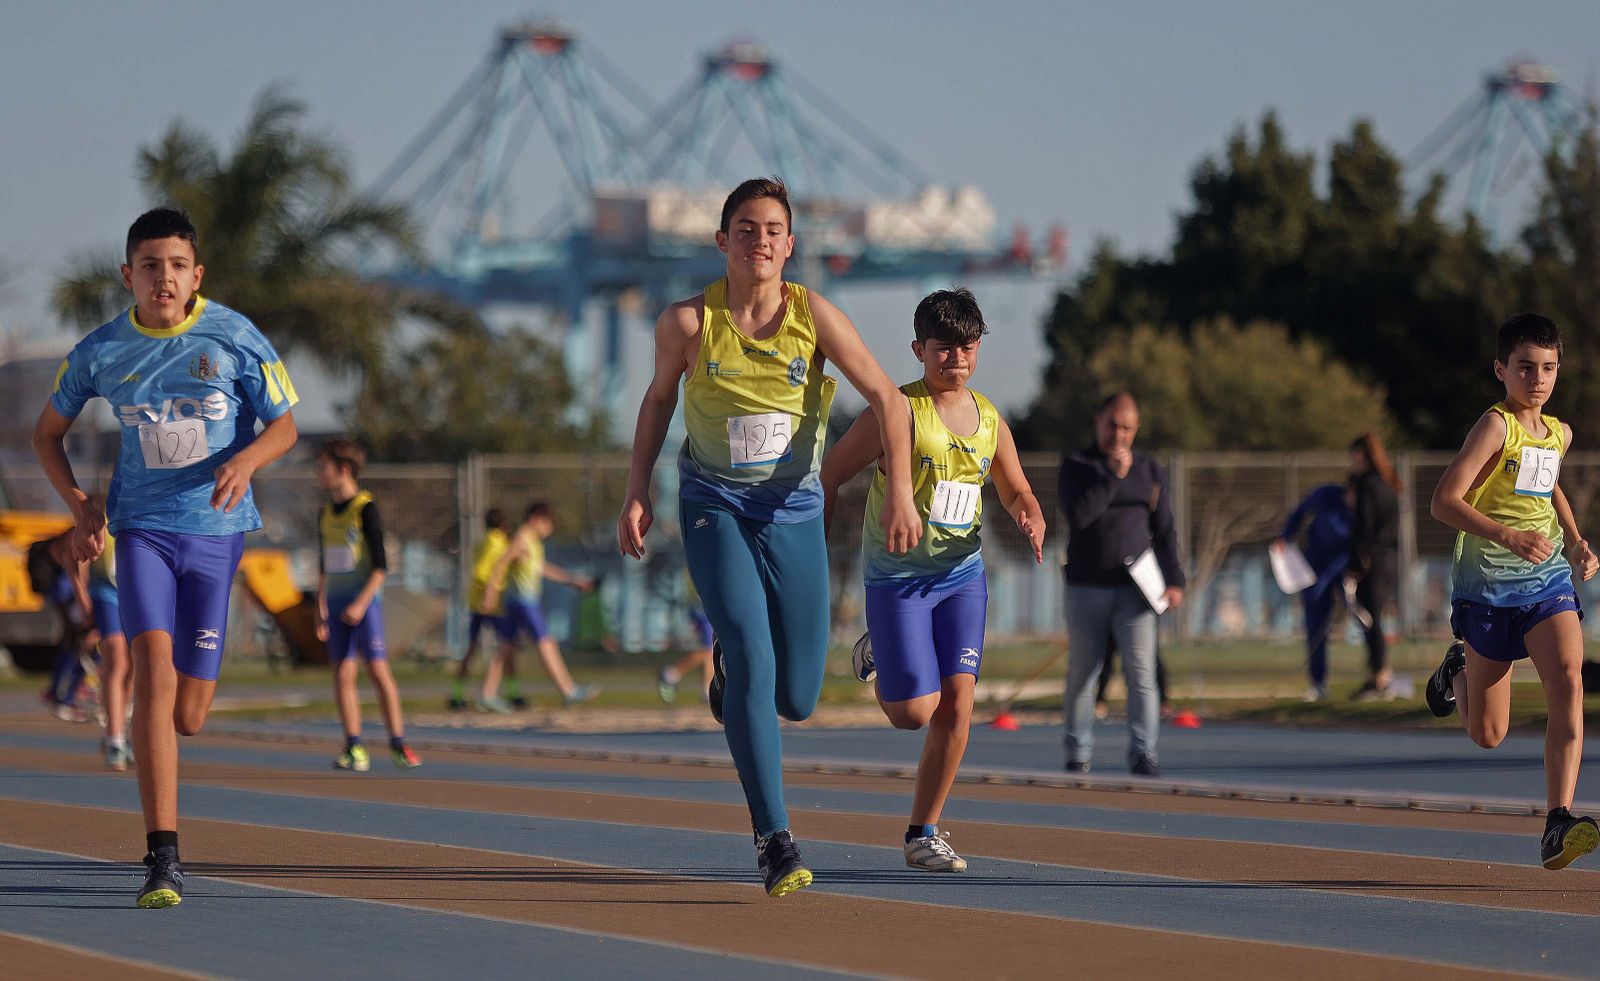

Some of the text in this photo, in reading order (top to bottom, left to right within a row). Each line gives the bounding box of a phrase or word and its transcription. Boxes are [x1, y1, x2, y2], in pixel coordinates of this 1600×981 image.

[155, 428, 203, 465] 122
[743, 422, 789, 461] 125
[1530, 453, 1553, 487] 15
[942, 488, 971, 522] 111
